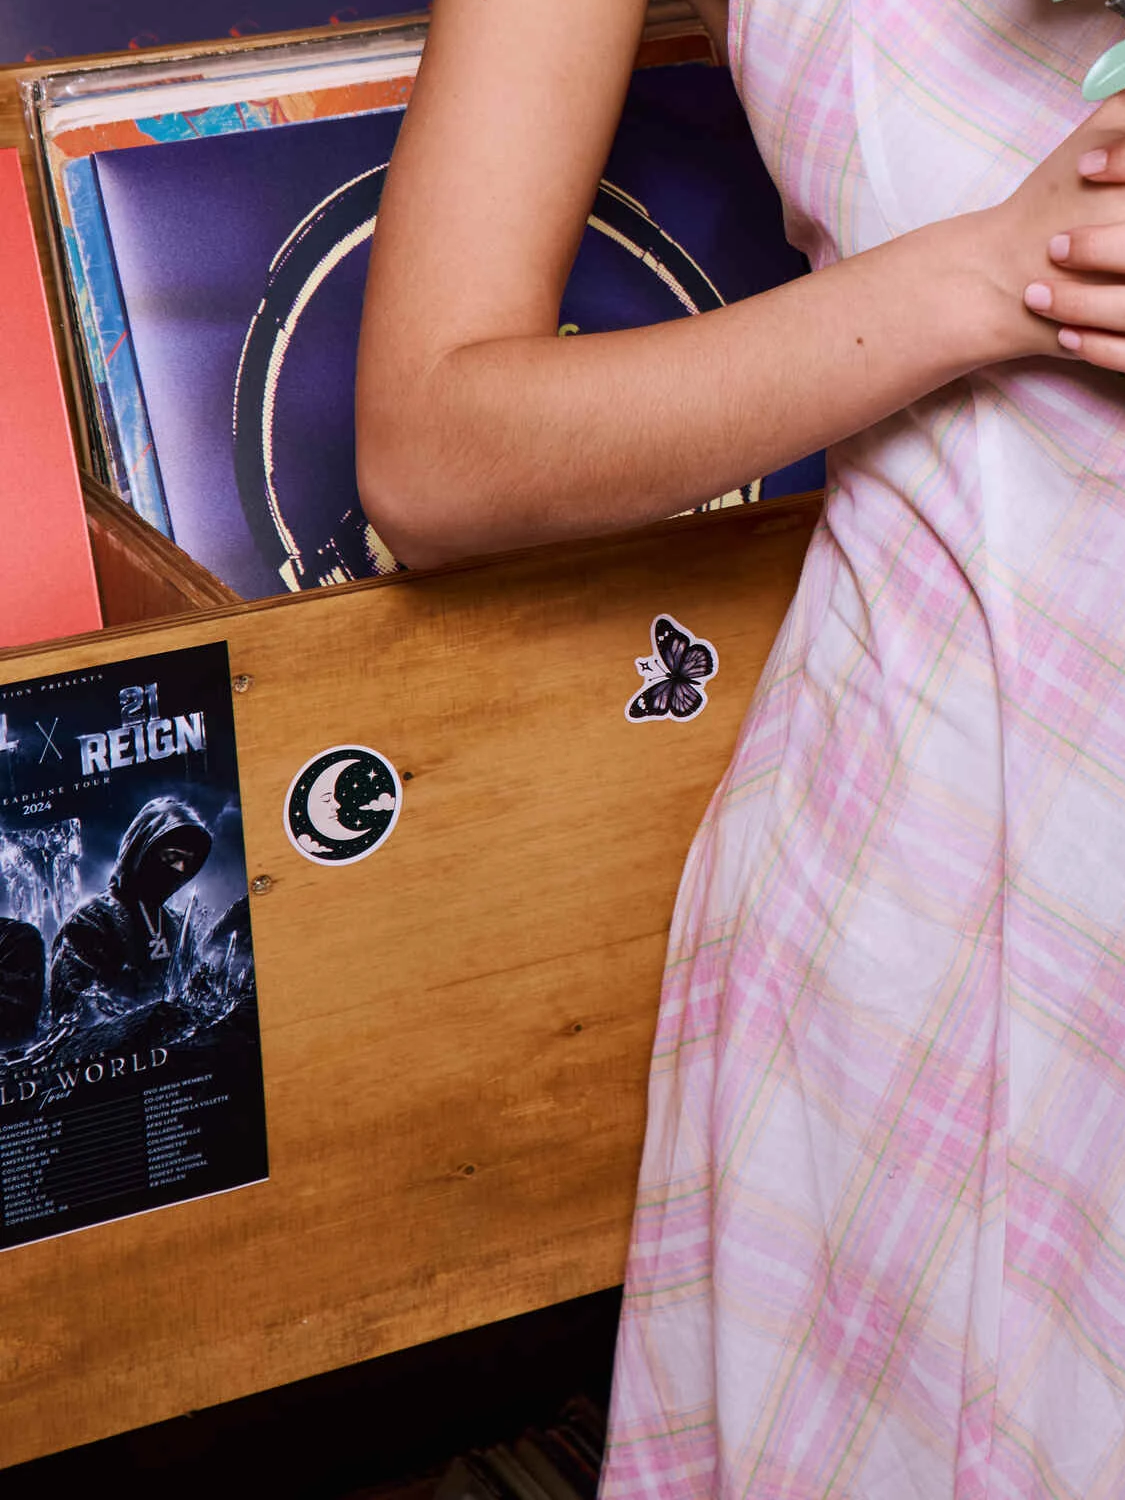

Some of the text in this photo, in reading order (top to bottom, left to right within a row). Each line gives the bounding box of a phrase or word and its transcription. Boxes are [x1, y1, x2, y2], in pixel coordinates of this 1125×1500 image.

[40, 674, 104, 692] PRESENTS
[118, 681, 161, 728] 21
[74, 710, 208, 776] REIGN
[73, 776, 111, 792] TOUR
[22, 800, 52, 816] 2024
[56, 1047, 168, 1091] WORLD
